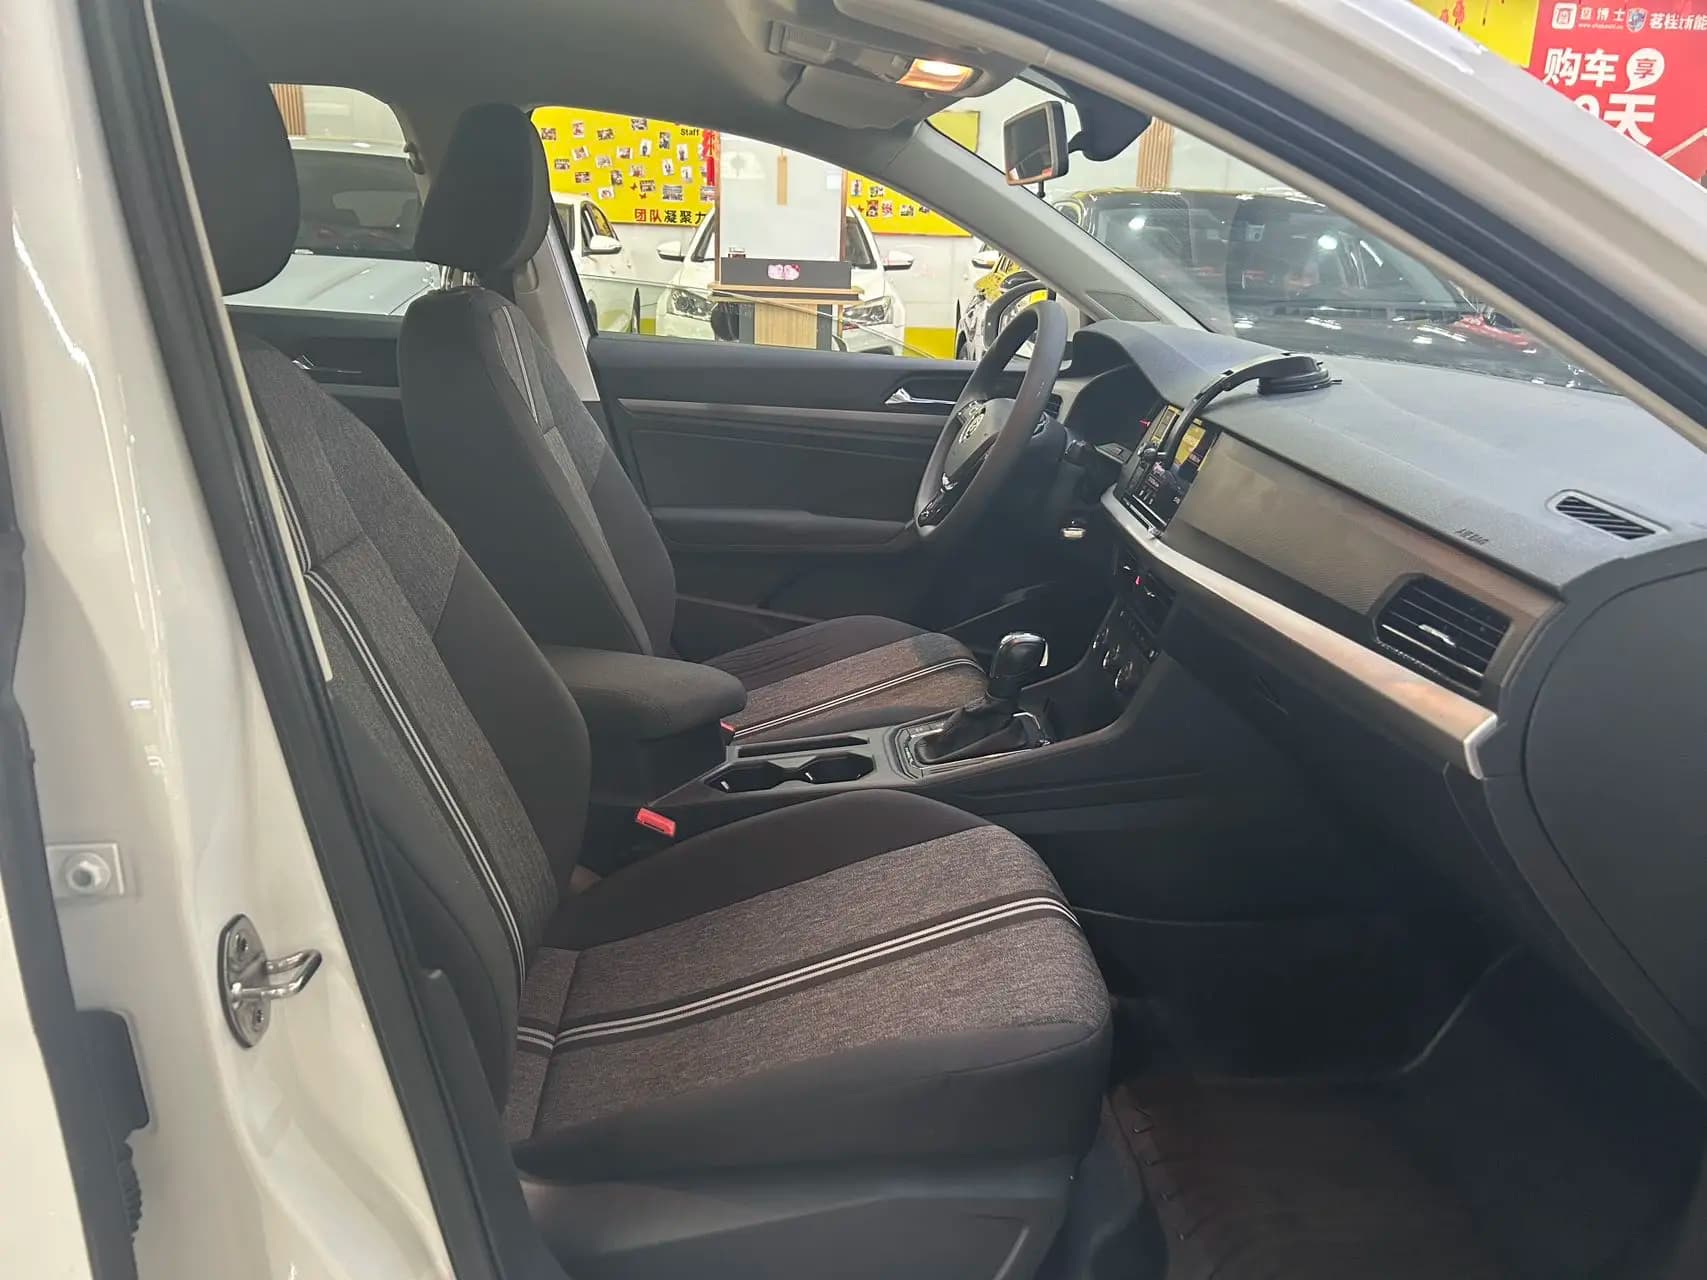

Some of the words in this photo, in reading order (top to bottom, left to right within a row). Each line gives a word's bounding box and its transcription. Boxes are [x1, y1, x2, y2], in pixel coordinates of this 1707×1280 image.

[1542, 47, 1620, 88] 购车
[1633, 57, 1657, 79] 享
[680, 128, 700, 137] Staff
